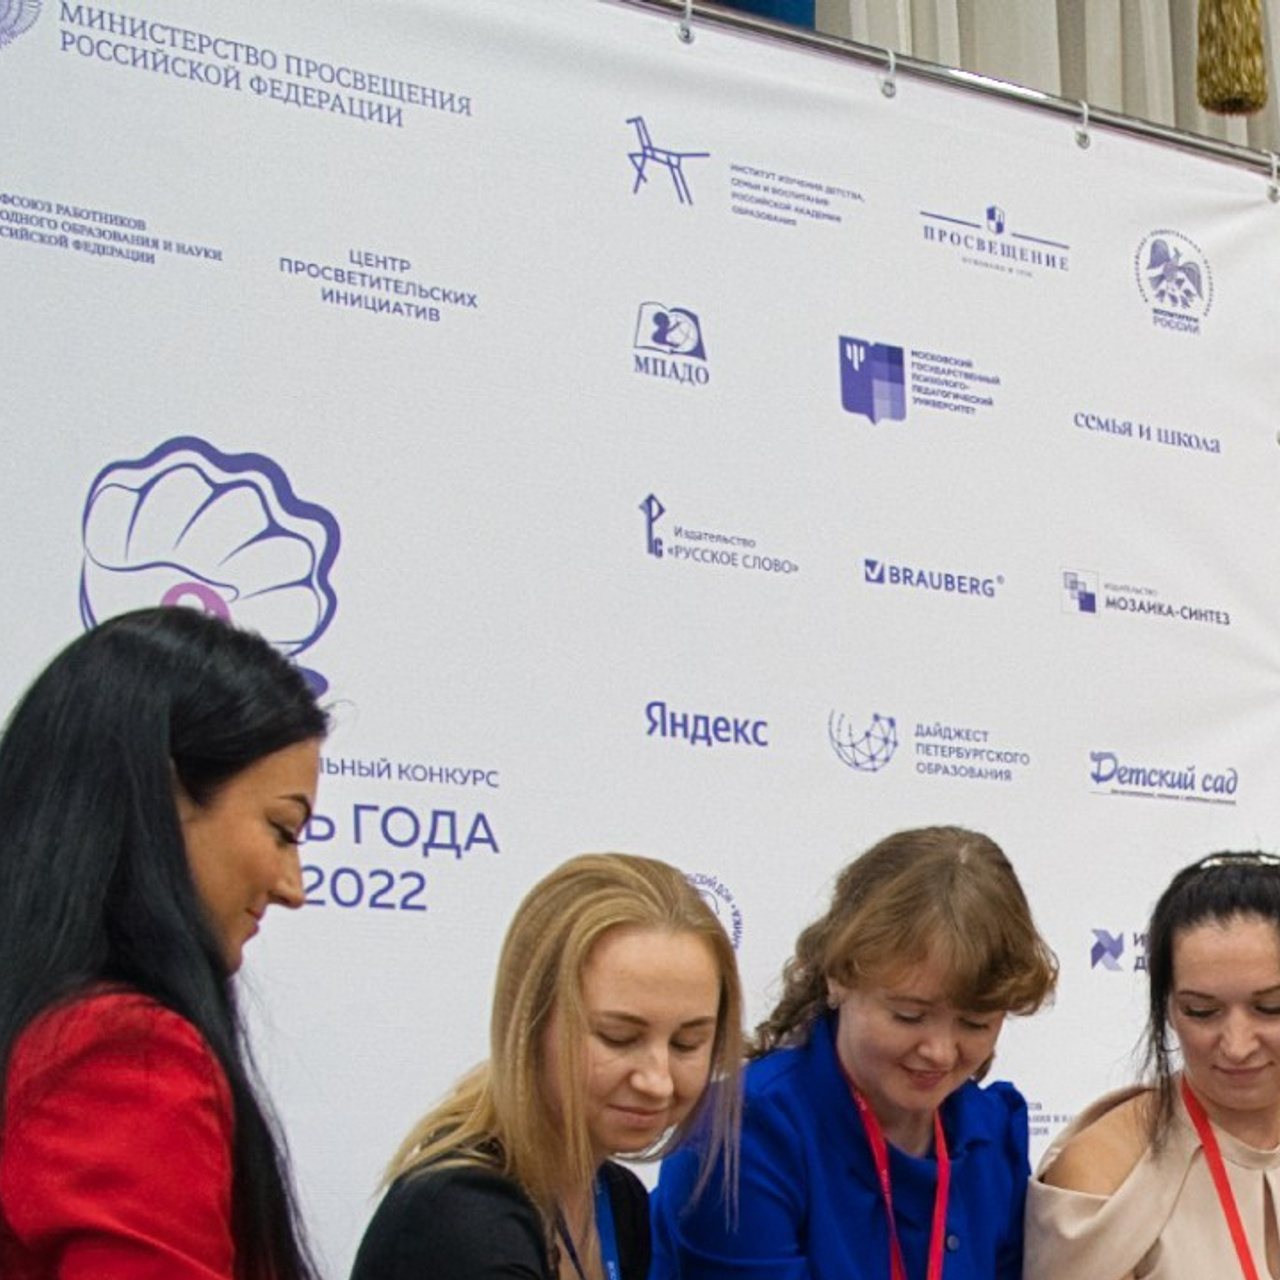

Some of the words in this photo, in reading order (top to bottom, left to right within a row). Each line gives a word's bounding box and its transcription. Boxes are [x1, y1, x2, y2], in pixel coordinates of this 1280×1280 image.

[59, 1, 277, 70] МИНИСТЕРСТВО
[285, 54, 472, 117] ПРОСВЕЩЕНИЯ
[60, 30, 242, 91] РОССИЙСКОЙ
[249, 75, 404, 128] ФЕДЕРАЦИИ
[56, 204, 146, 231] РАБОТНИКОВ
[61, 221, 160, 251] ОБРАЗОВАНИЯ
[163, 240, 173, 252] И
[176, 243, 223, 262] НАУКИ
[72, 238, 155, 264] ФЕДЕРАЦИИ
[924, 225, 1069, 271] ПРОСВЕЩЕНИЕ
[349, 249, 411, 273] ЦЕНТР
[279, 257, 478, 308] ПРОСВЕТИТЕЛЬСКИХ
[321, 287, 441, 322] ИНИЦИАТИВ
[1152, 315, 1200, 335] РОССИИ
[633, 354, 709, 386] МПАДО
[911, 350, 973, 368] МОСКОВСКИЙ
[911, 361, 1000, 385] ГОСУДАРСТВЕННЫЙ
[911, 373, 970, 391] ПСИХОЛОГО-
[912, 384, 994, 407] ПЕДАГОГИЧЕСКИЙ
[912, 397, 976, 415] УНИВЕРСИТЕТ
[674, 525, 756, 548] Издательство
[667, 545, 738, 567] «РУССКОЕ
[742, 553, 799, 574] СЛОВО»
[1105, 596, 1231, 626] МОЗАИКА-СИНТЕЗ
[646, 701, 768, 747] Яндекс
[915, 722, 989, 743] ДАЙДЖЕСТ
[916, 743, 1030, 766] ПЕТЕРБУРГСКОГО
[398, 763, 499, 788] КОНКУРС
[916, 762, 1012, 781] ОБРАЗОВАНИЯ
[1090, 751, 1195, 791] Детский
[1201, 768, 1238, 794] сад
[353, 803, 500, 860] ГОДА
[301, 865, 427, 911] 2022
